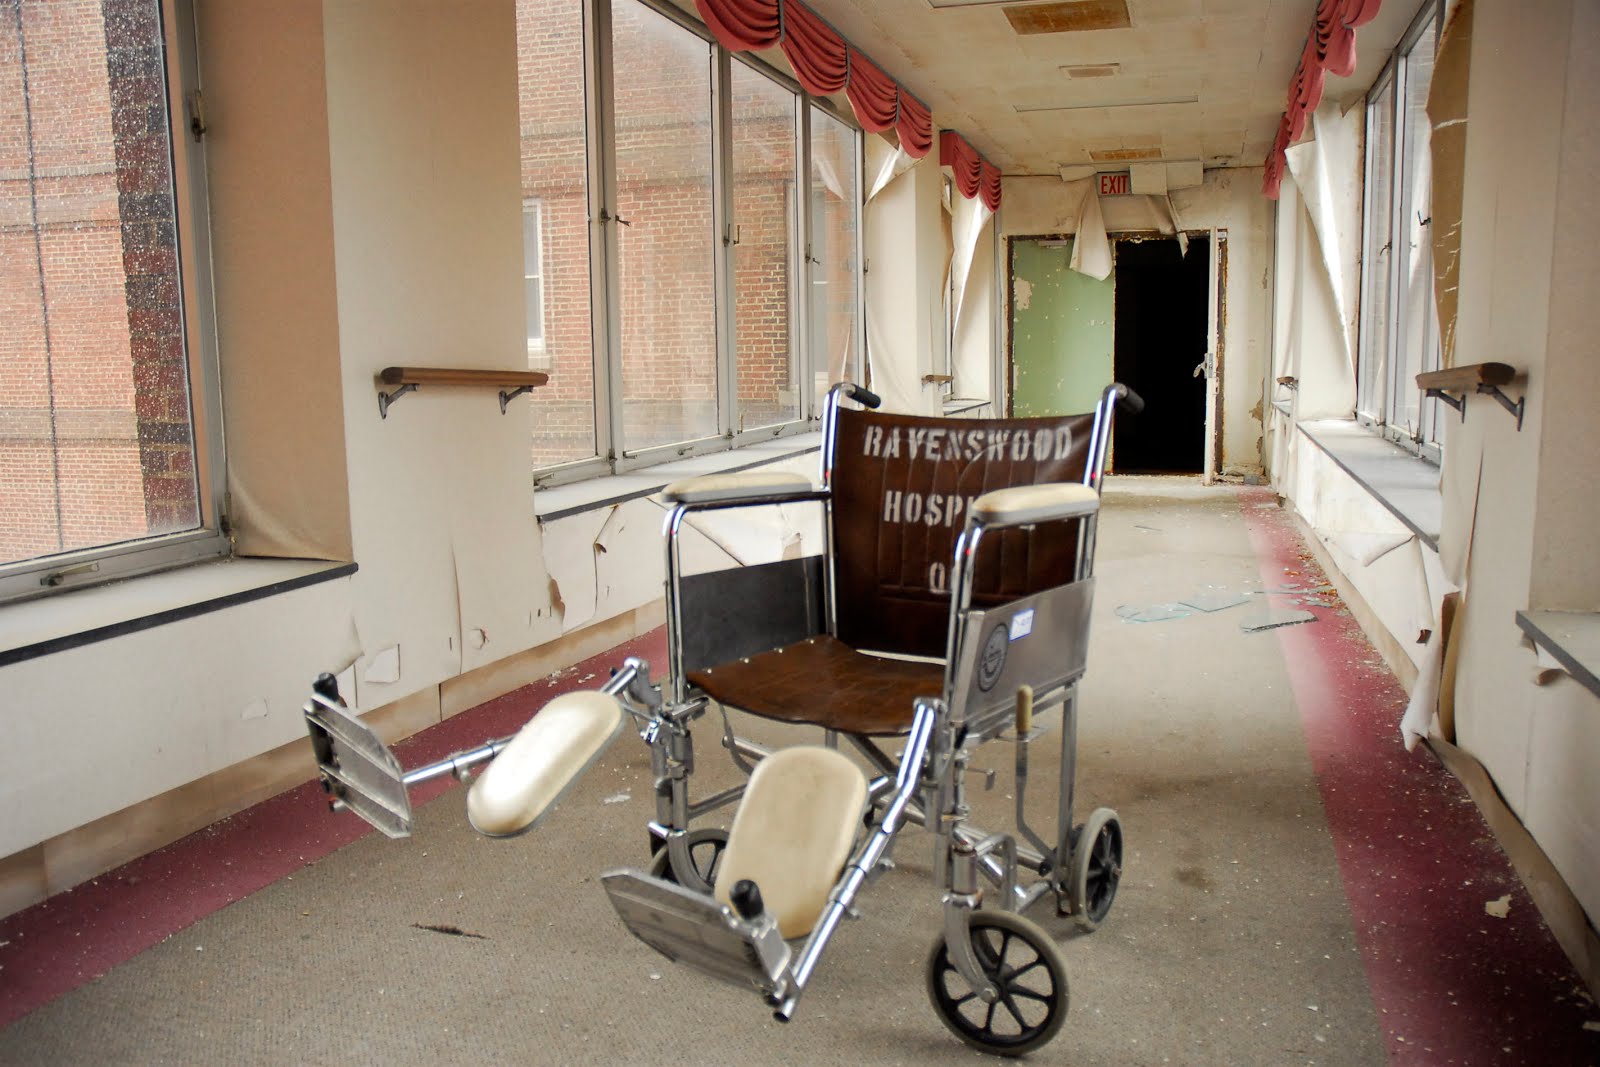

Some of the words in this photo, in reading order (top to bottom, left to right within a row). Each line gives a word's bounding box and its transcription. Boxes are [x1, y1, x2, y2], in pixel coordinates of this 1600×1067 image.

[1101, 175, 1128, 195] EXIT
[863, 425, 1073, 461] RAVENSWOOD
[883, 490, 974, 527] HOSPI
